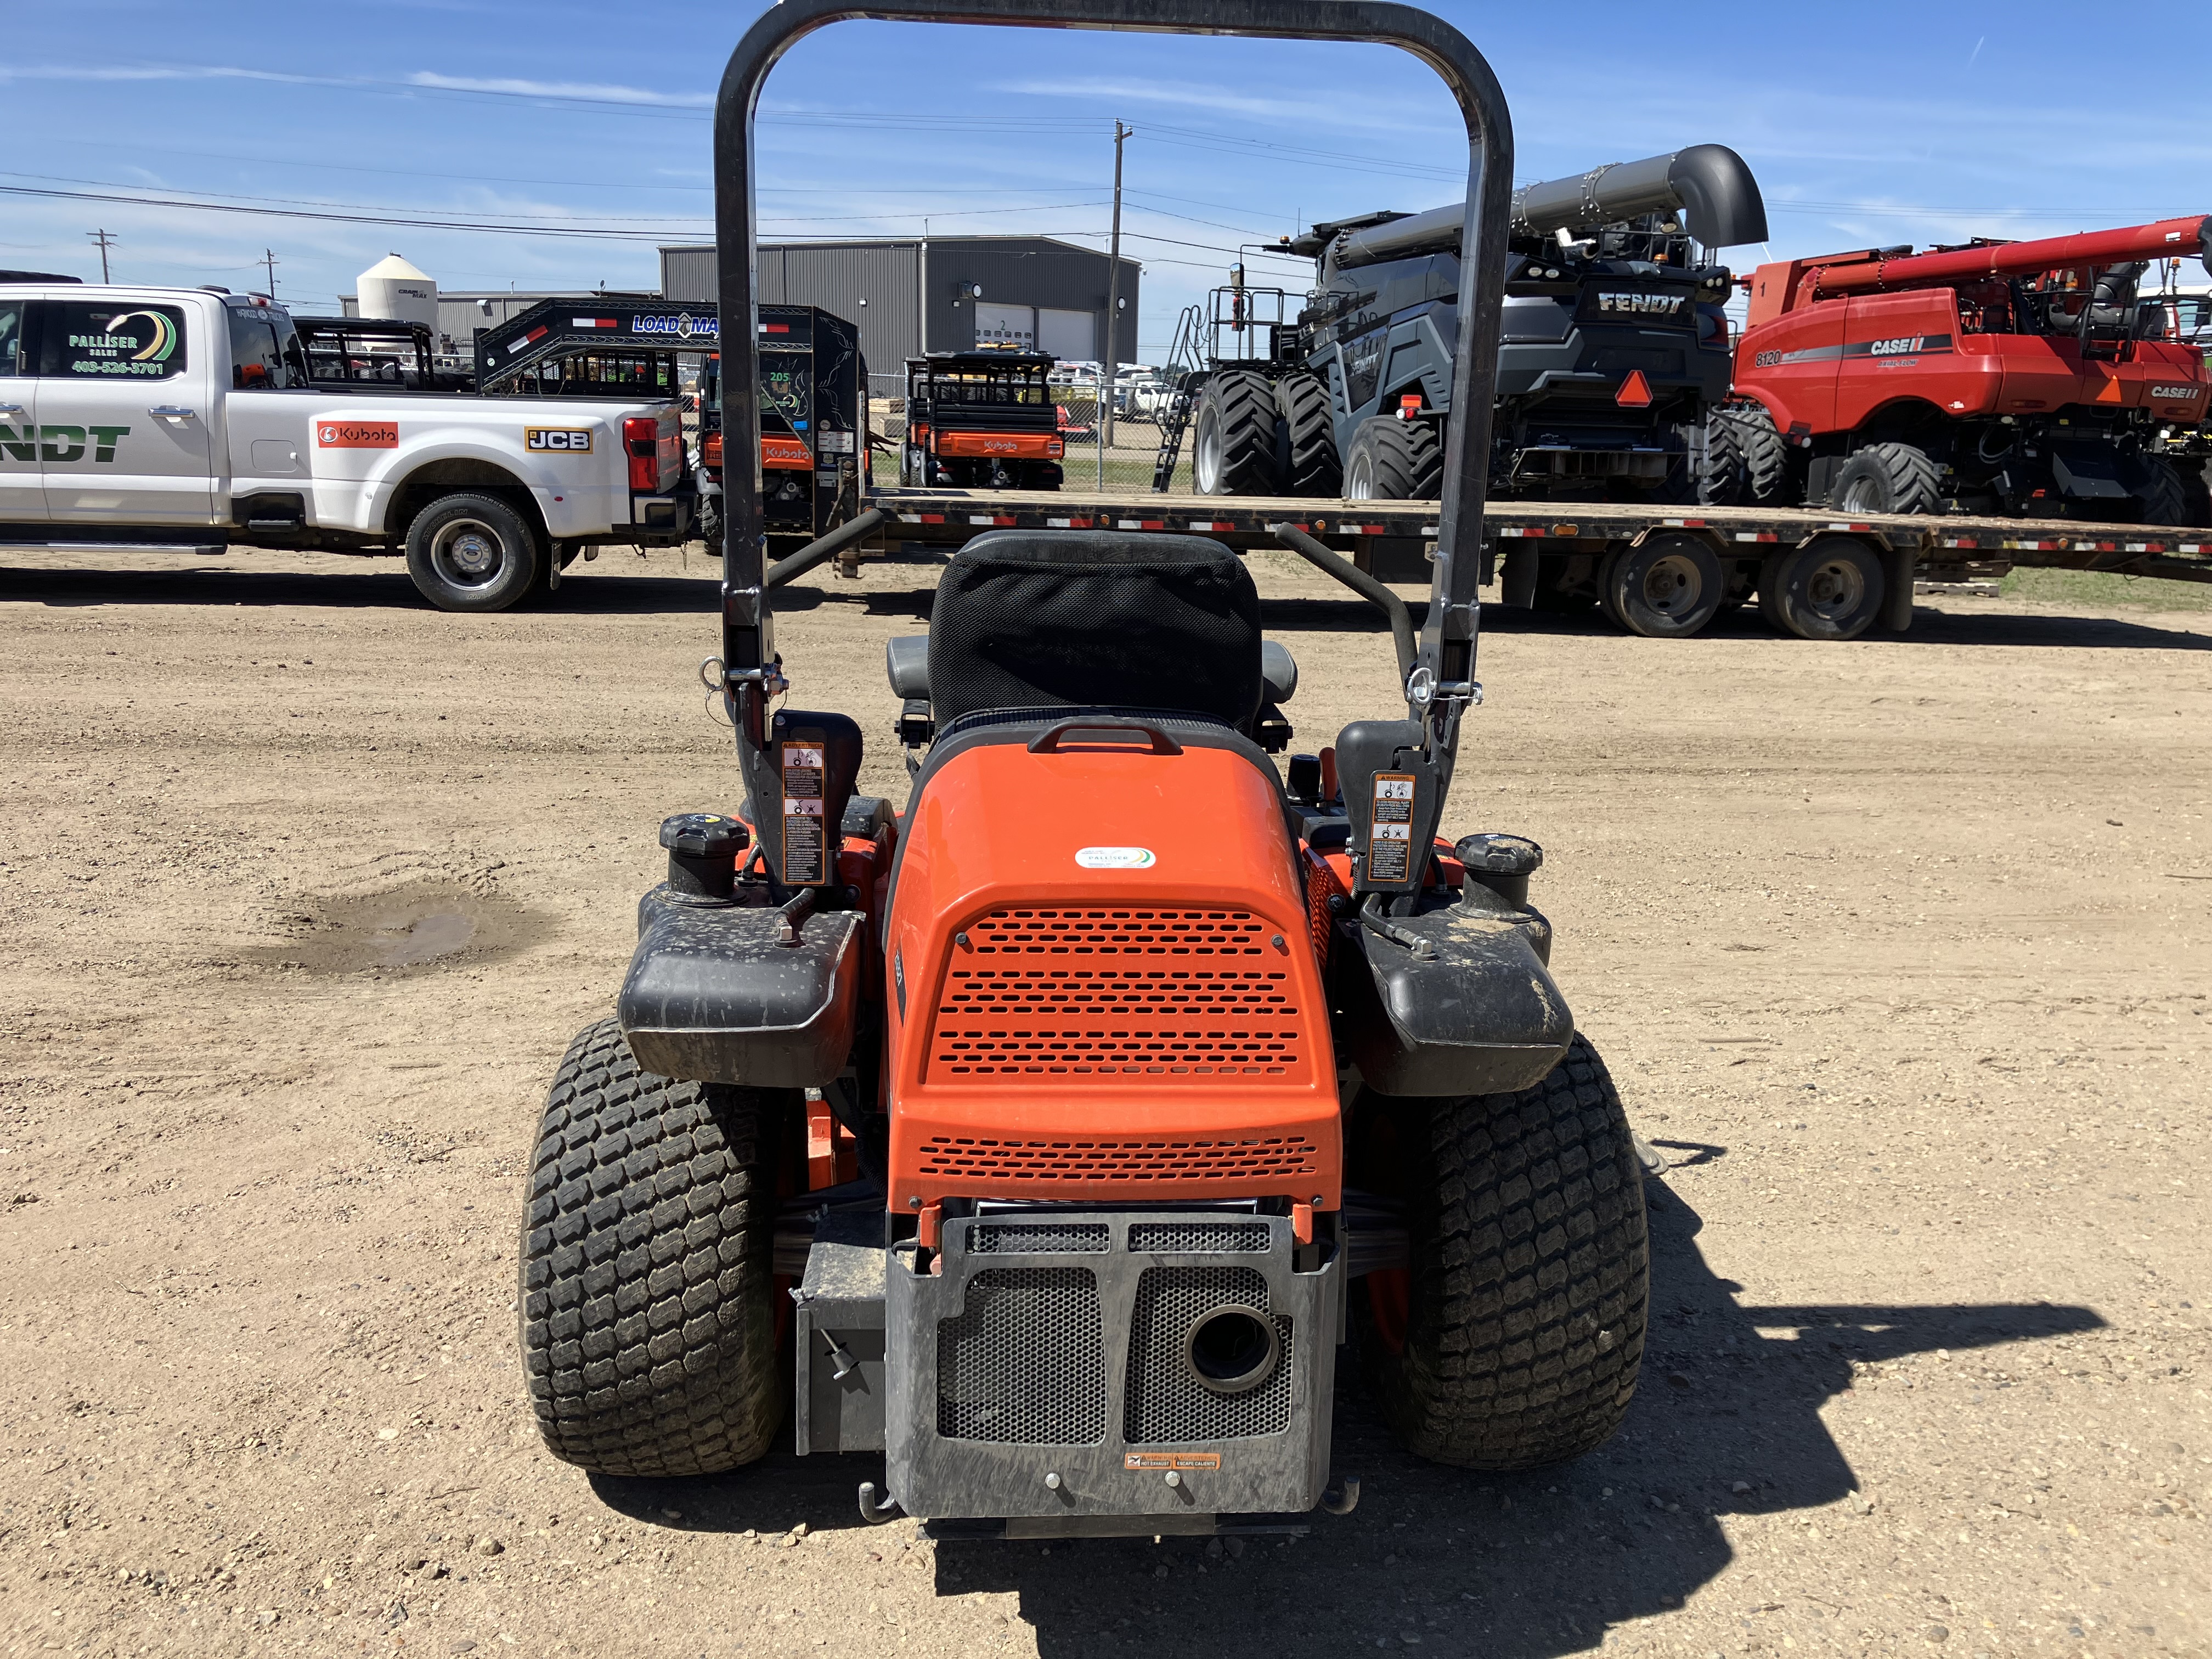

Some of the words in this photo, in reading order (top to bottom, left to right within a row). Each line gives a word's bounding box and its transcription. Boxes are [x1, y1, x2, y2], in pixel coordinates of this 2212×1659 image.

[1598, 292, 1685, 314] FENDT
[632, 315, 680, 332] LOAD
[690, 317, 719, 337] MA
[1001, 320, 1005, 330] 2
[69, 334, 137, 348] PALLISER
[1756, 349, 1782, 368] 8120
[72, 360, 163, 375] 403-526-3701
[770, 372, 789, 381] 205
[340, 428, 396, 441] Kubota
[529, 431, 589, 449] JCB
[766, 447, 809, 459] Kubota
[984, 441, 1017, 450] Kubota
[422, 509, 468, 543] MICHELIN
[467, 567, 513, 600] MICHELIN
